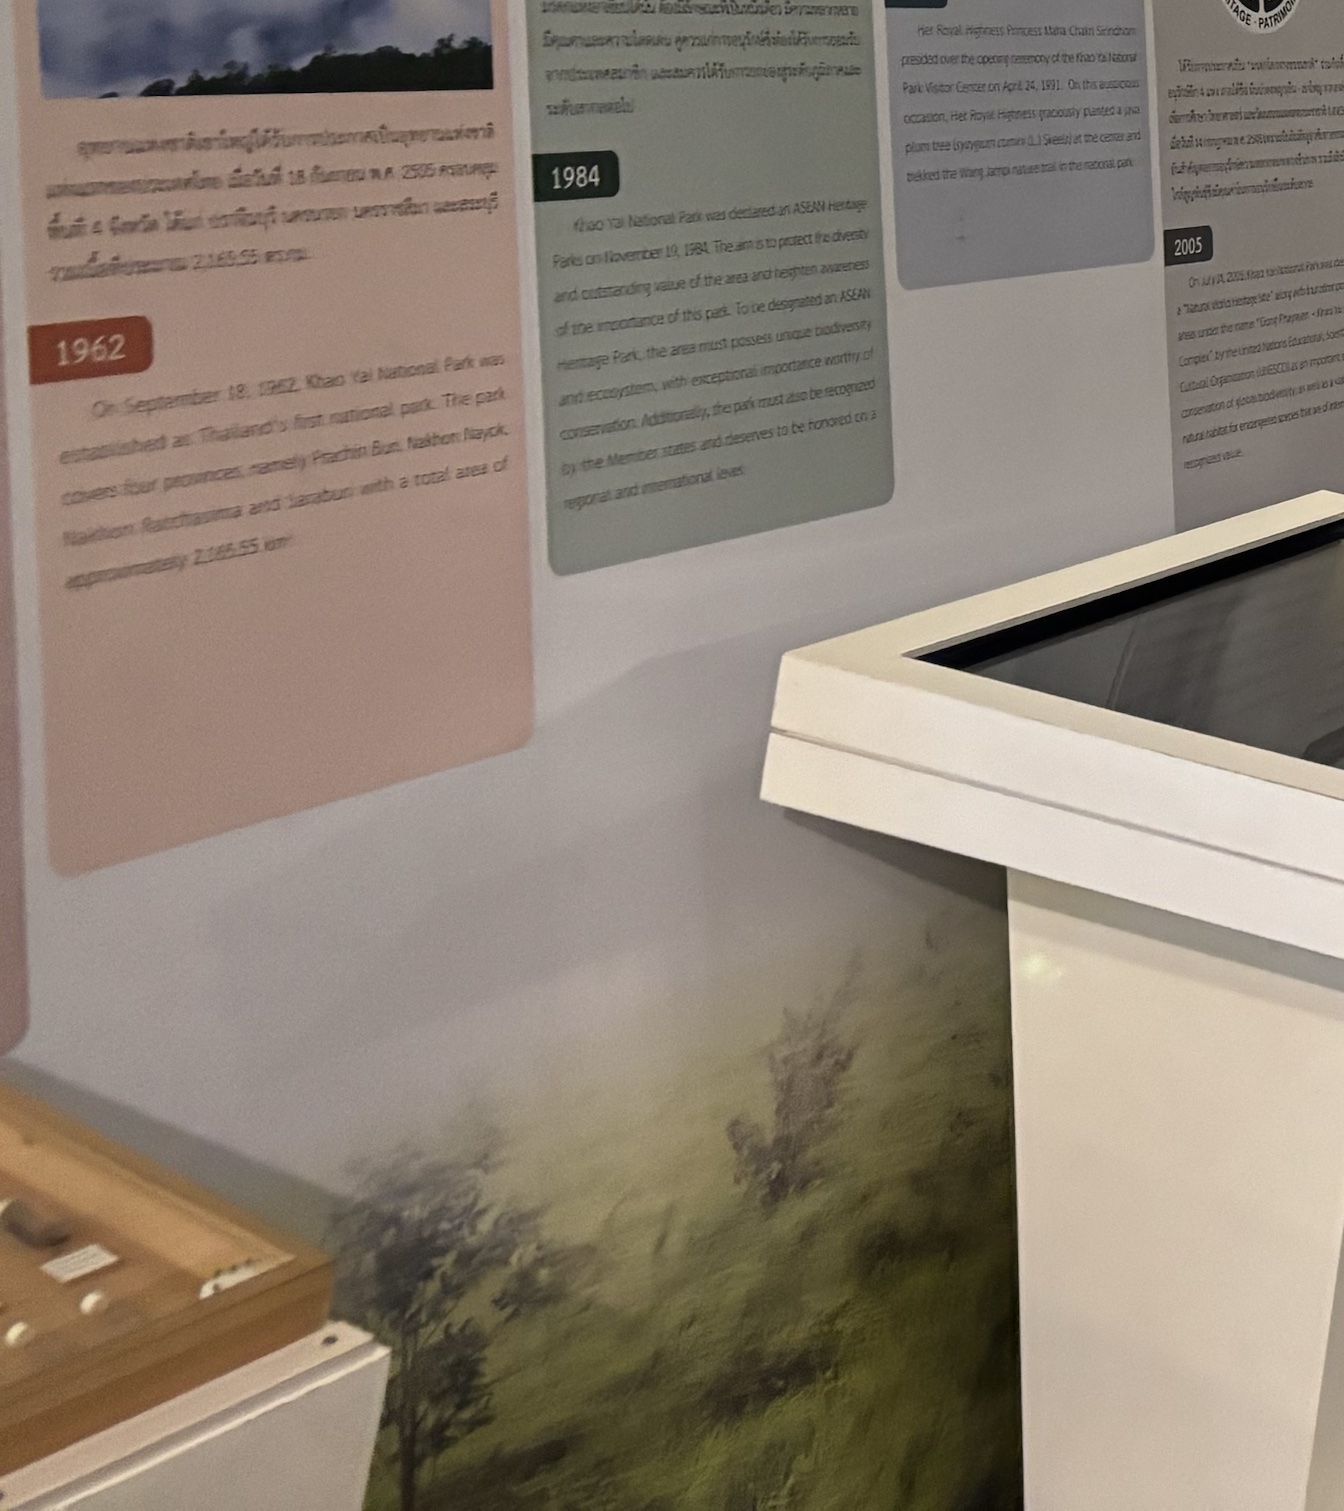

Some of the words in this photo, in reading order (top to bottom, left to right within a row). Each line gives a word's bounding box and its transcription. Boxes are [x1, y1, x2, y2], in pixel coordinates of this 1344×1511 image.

[550, 164, 601, 190] 1984
[1173, 236, 1203, 257] 2005
[57, 333, 127, 367] 1962
